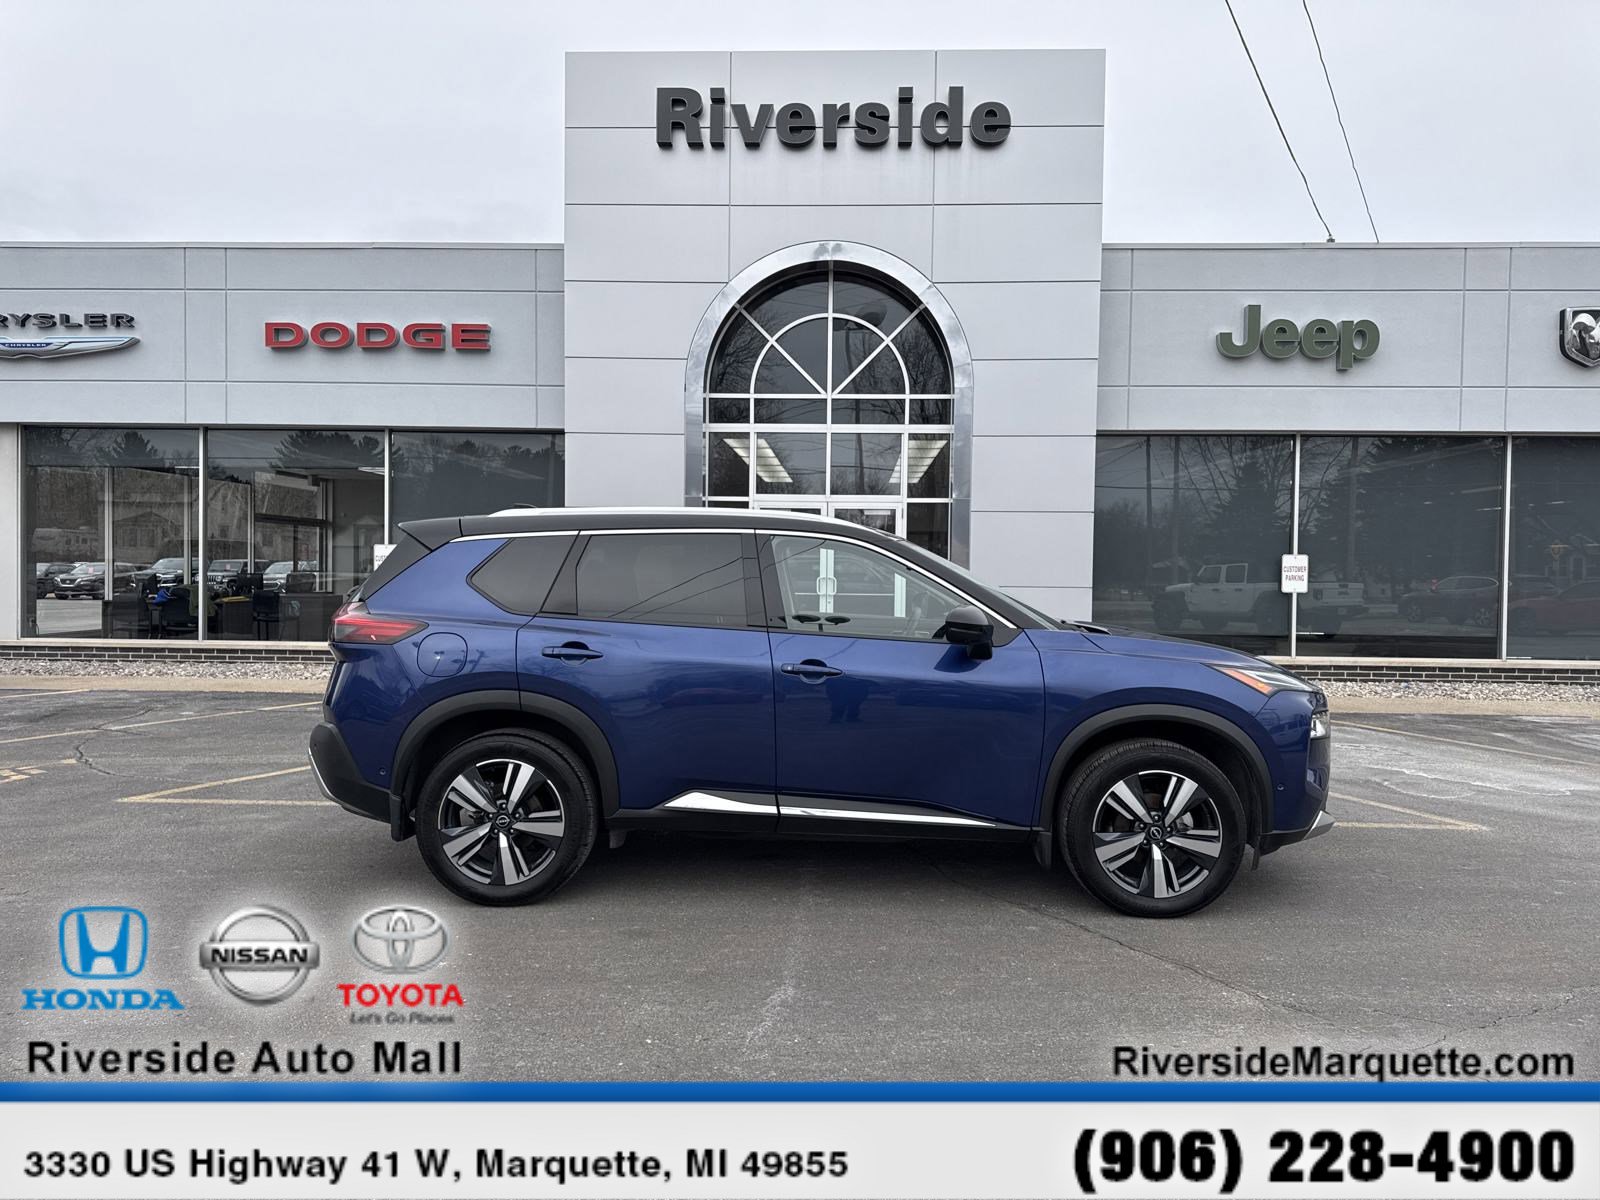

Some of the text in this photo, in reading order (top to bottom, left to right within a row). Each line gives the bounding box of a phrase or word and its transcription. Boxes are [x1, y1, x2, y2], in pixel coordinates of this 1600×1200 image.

[656, 86, 1012, 150] Riverside
[264, 321, 492, 352] DODGE
[1215, 304, 1381, 372] Jeep
